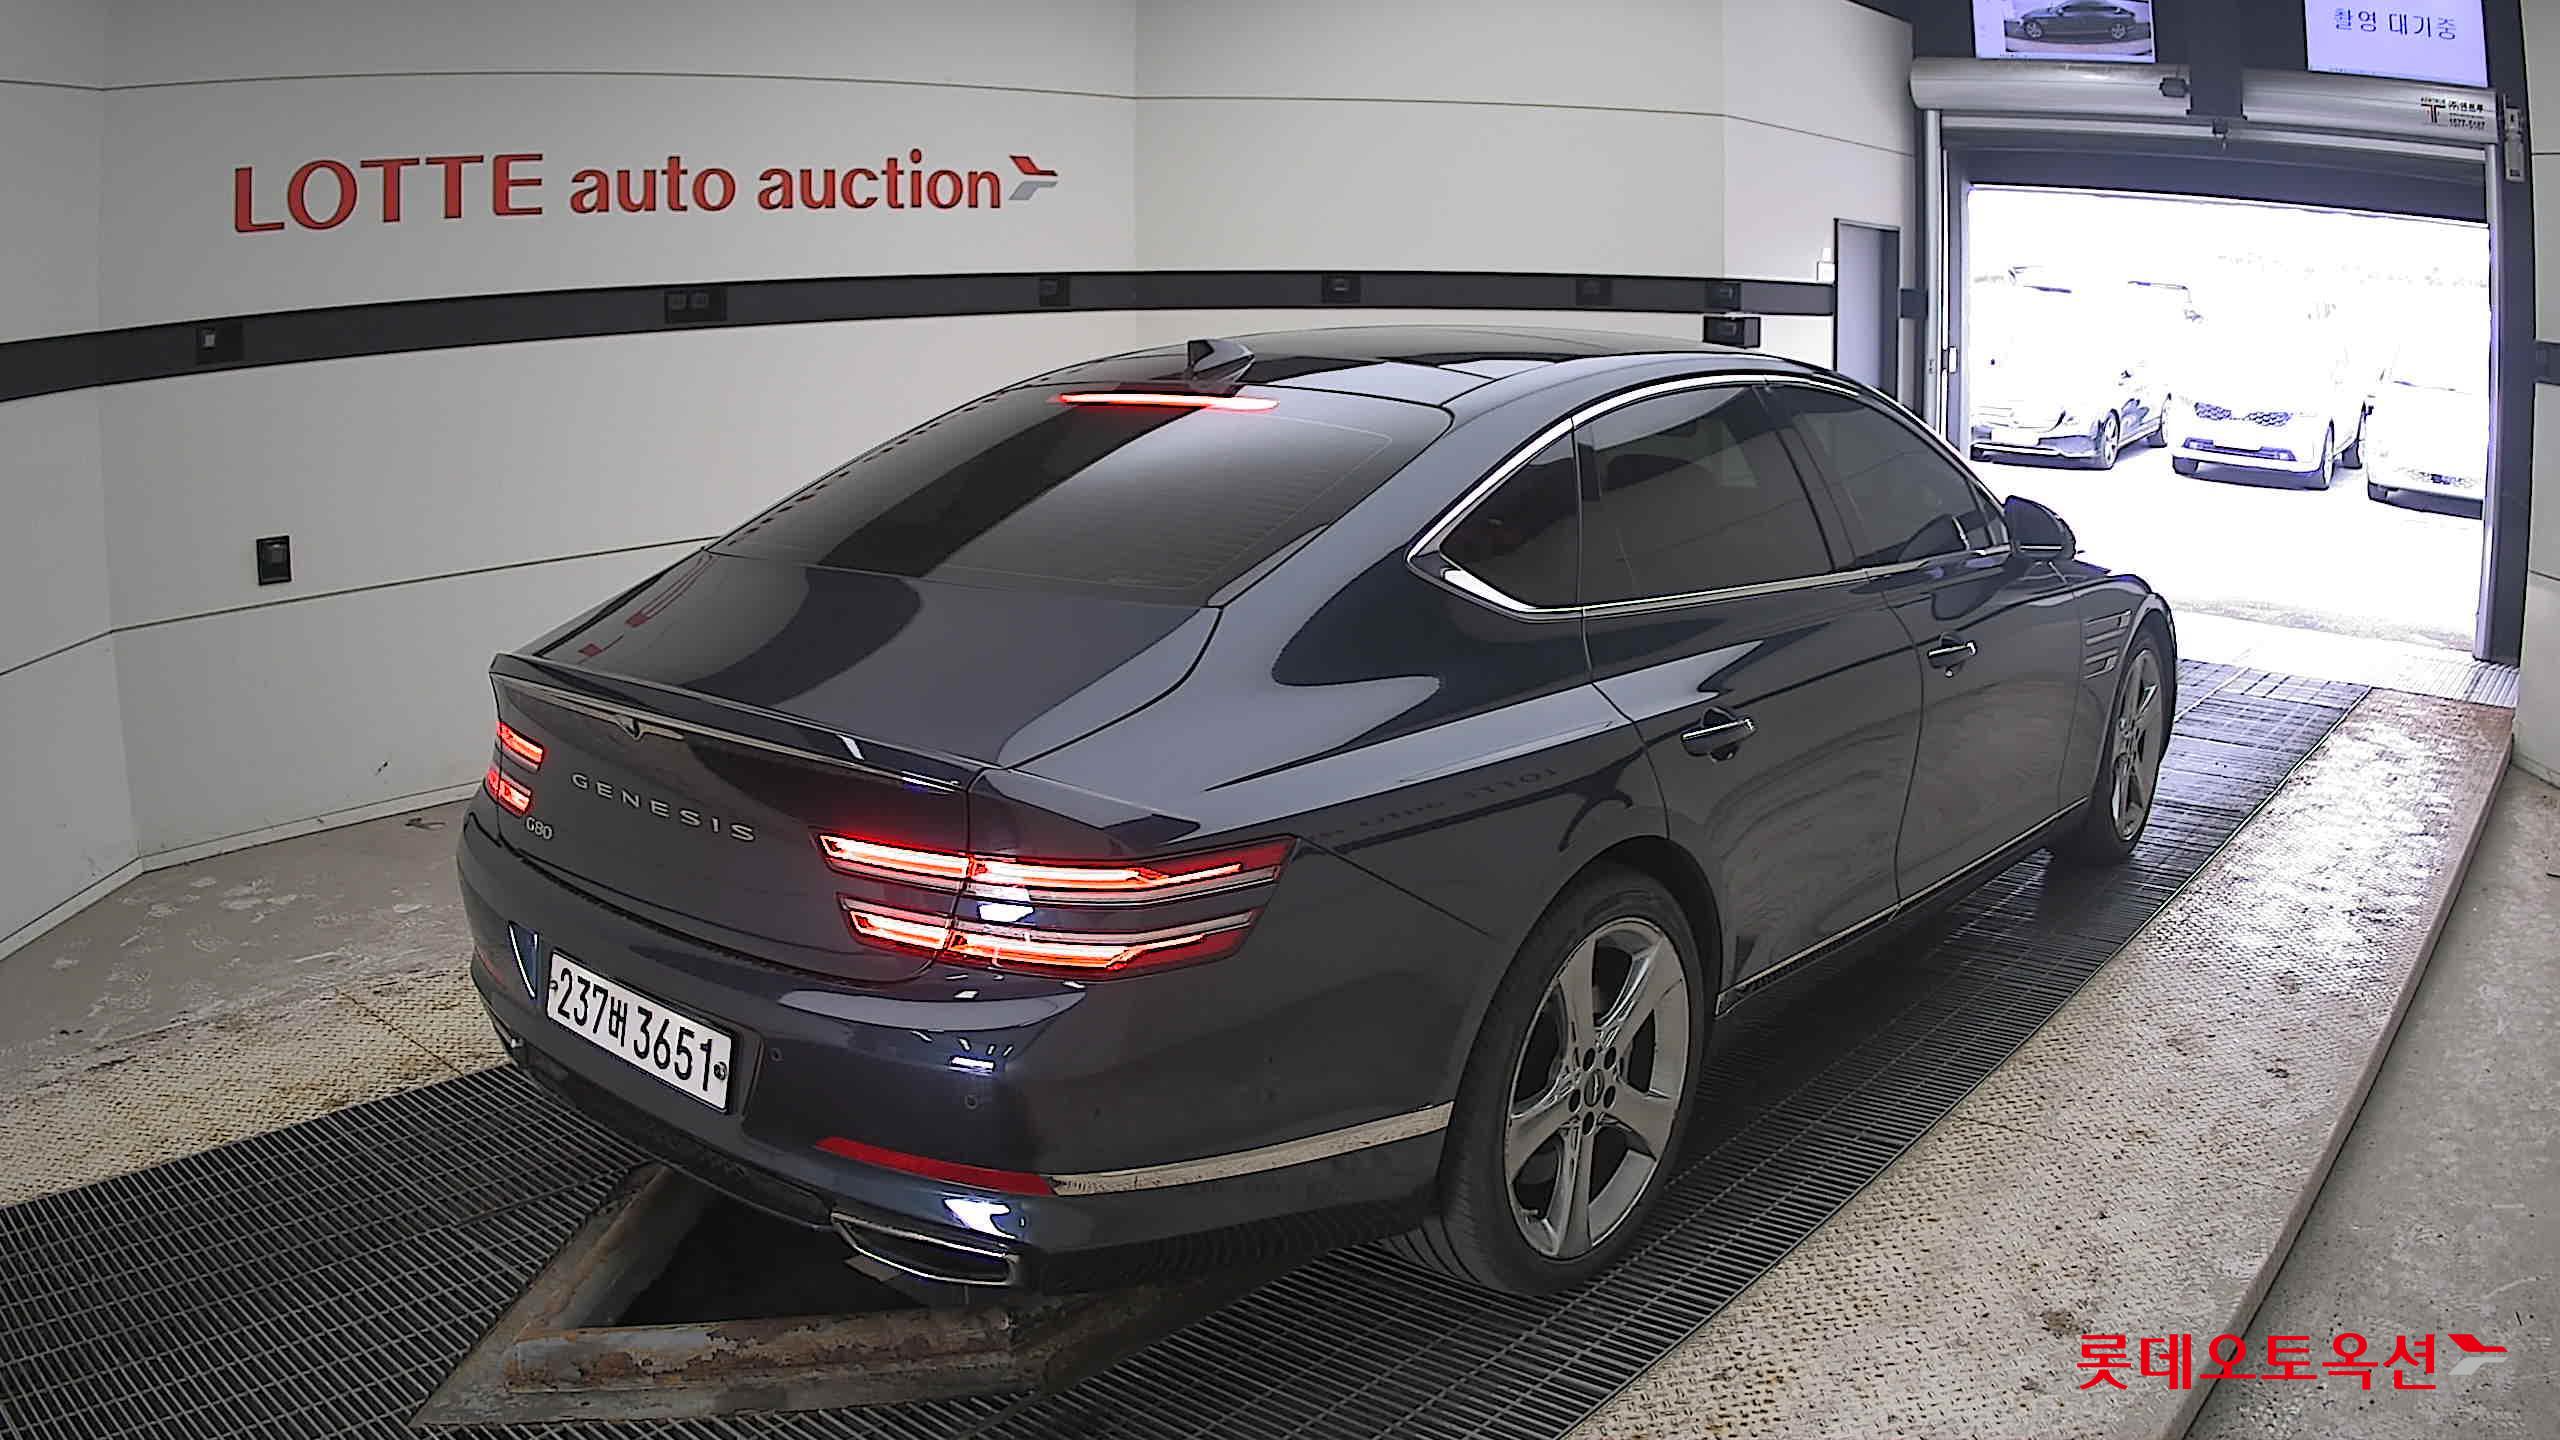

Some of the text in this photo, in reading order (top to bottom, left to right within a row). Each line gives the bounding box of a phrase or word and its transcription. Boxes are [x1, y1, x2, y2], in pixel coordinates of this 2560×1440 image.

[2335, 8, 2456, 40] 촬영 대기중
[234, 148, 1002, 233] LOTTE auto auction
[526, 816, 553, 840] G80
[570, 773, 756, 842] GENESIS
